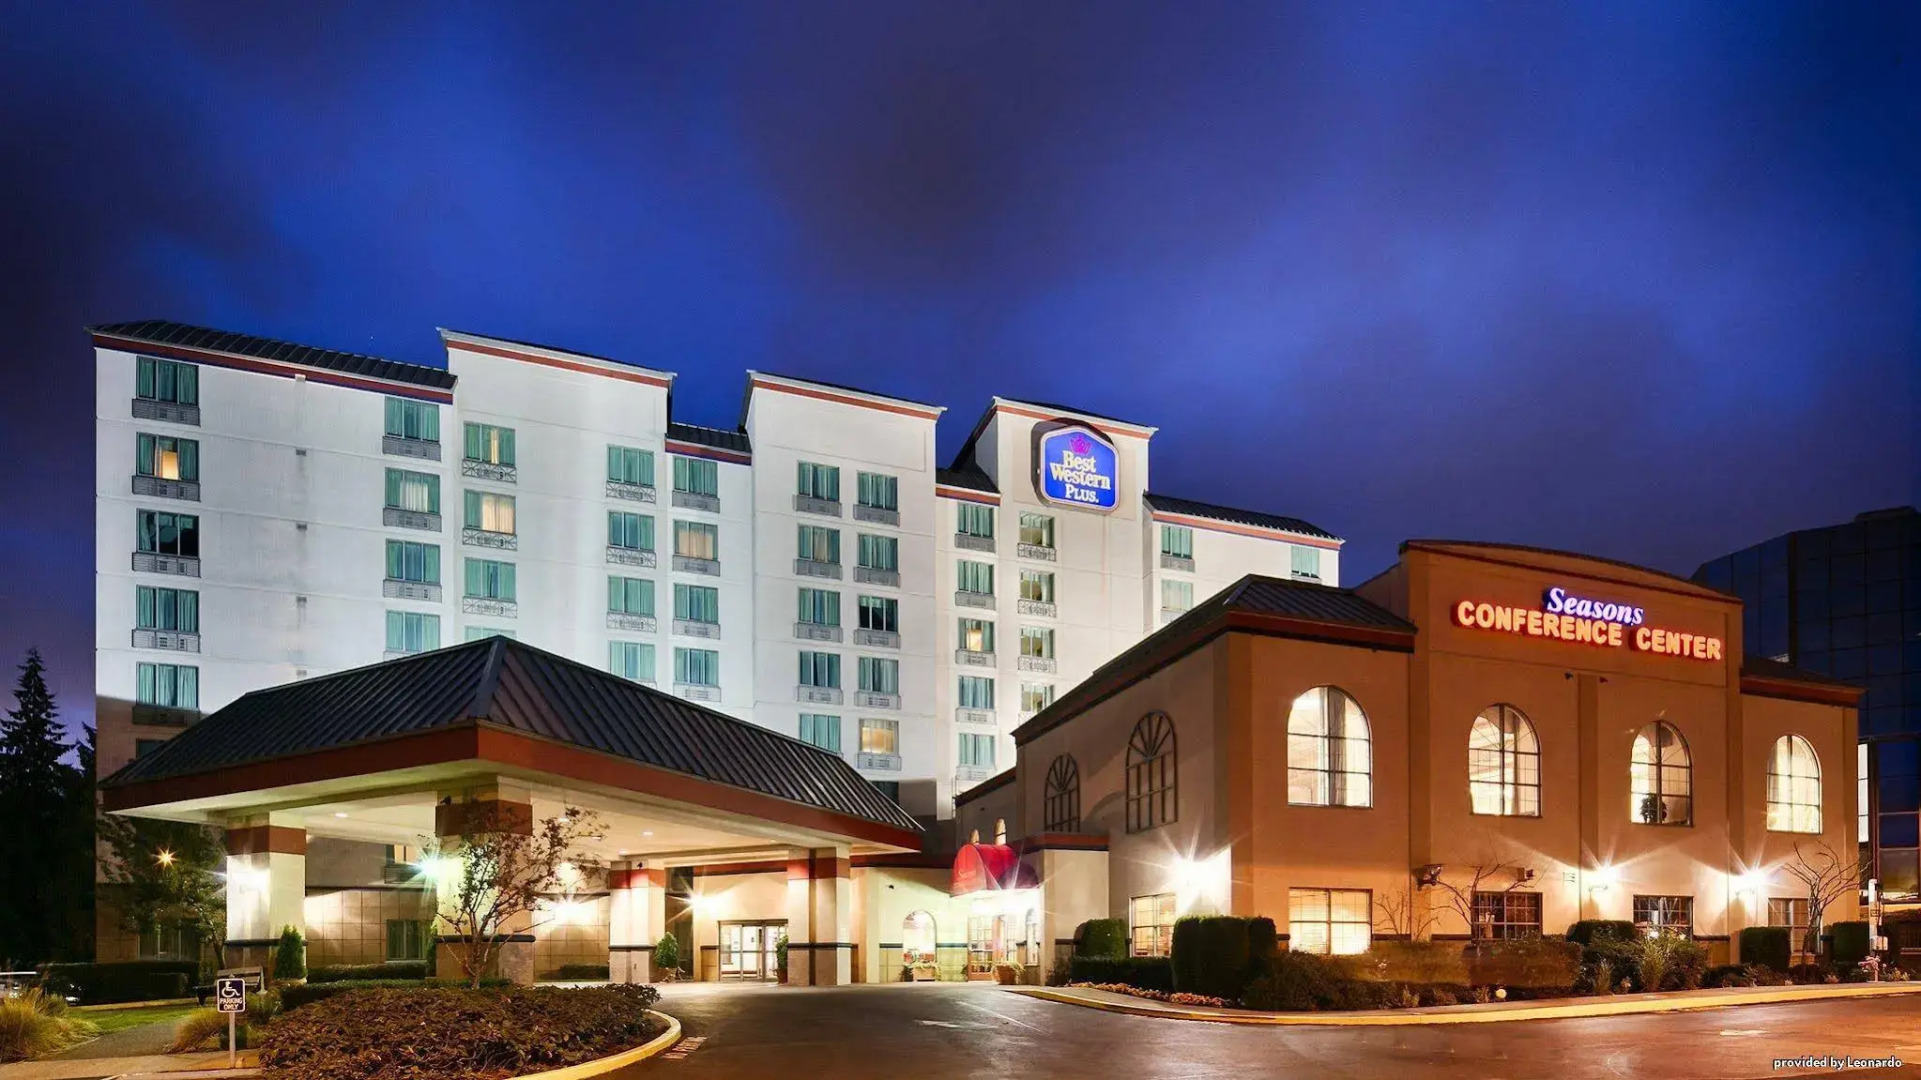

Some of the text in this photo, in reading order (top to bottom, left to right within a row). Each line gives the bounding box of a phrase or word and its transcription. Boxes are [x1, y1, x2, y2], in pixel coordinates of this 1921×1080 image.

[1049, 462, 1111, 490] Western
[1063, 450, 1096, 472] Best
[1547, 587, 1644, 625] Seasons
[1457, 600, 1722, 660] CONFERENCE CENTER
